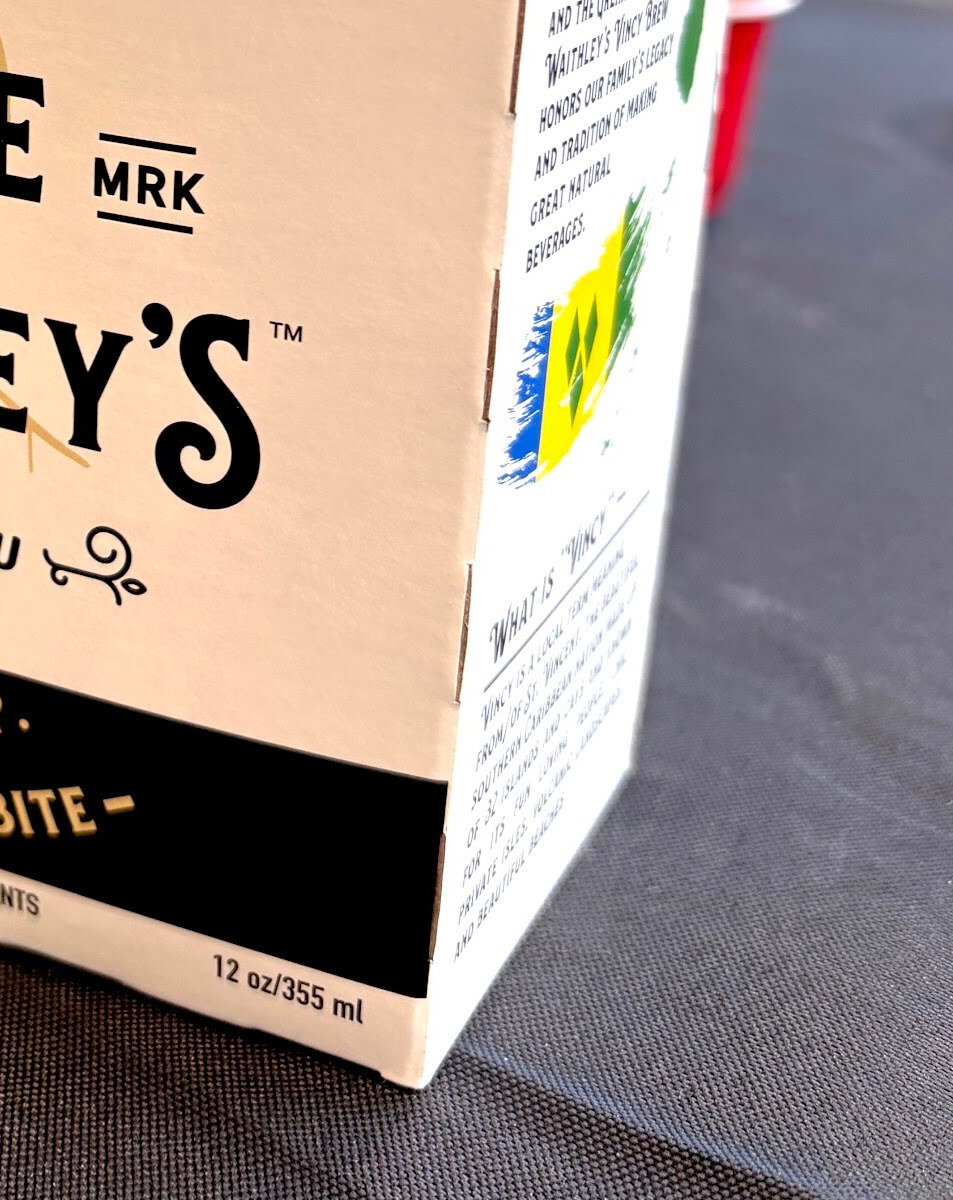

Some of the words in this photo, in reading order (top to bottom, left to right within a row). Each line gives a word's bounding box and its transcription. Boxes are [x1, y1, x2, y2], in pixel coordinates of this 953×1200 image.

[544, 25, 611, 89] WAITHLEY'S
[614, 12, 644, 52] VINCY
[645, 0, 669, 32] BREW
[548, 5, 572, 38] AND
[538, 88, 583, 134] HONORS
[584, 76, 605, 108] OUR
[605, 49, 645, 95] FAMILY'S
[645, 34, 674, 70] LEGACY
[534, 147, 558, 181] AND
[561, 112, 612, 165] TRADITION
[613, 103, 626, 131] OF
[627, 81, 658, 119] MAKING
[93, 157, 206, 215] MRK
[530, 183, 566, 227] GREAT
[568, 156, 611, 203] NATURAL
[525, 212, 586, 274] BEVERAGES.
[213, 953, 240, 984] 12
[247, 971, 325, 1011] oz/355
[332, 997, 363, 1024] ml
